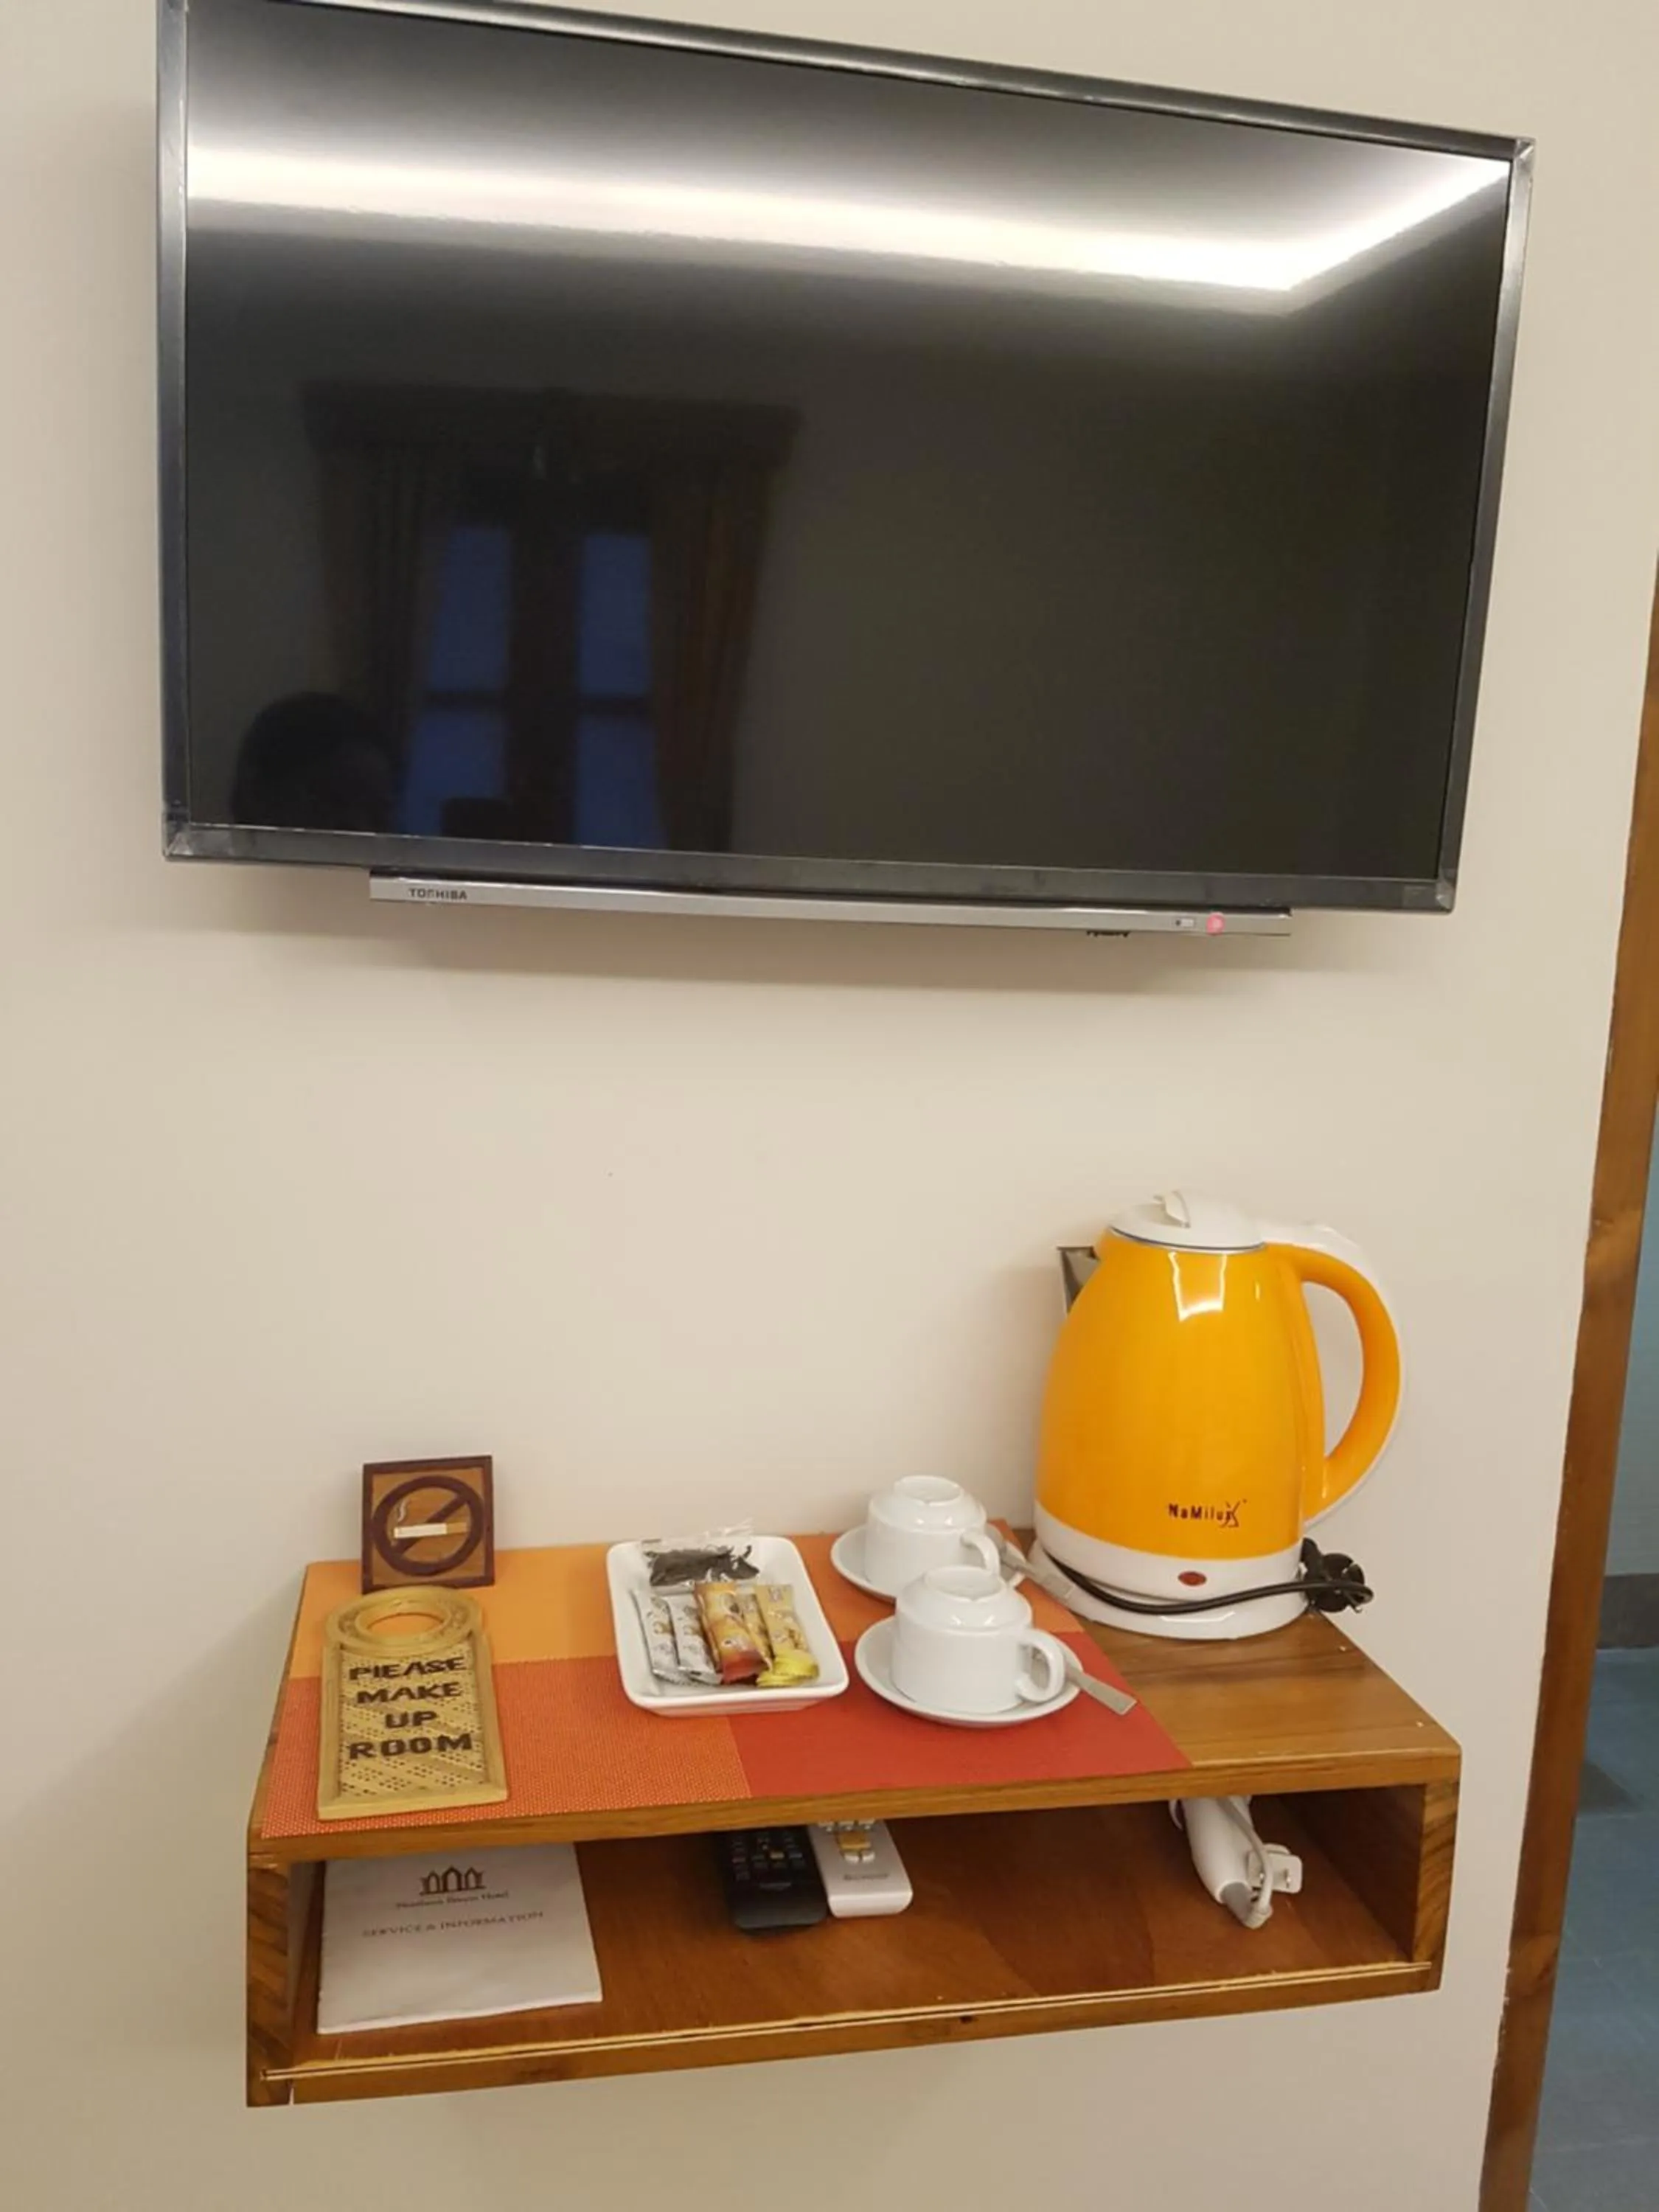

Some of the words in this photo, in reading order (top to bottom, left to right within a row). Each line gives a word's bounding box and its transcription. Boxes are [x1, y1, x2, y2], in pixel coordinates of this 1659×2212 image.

[409, 888, 467, 900] TOSHIBA
[357, 1682, 462, 1703] MAKE
[385, 1711, 437, 1728] UP
[349, 1733, 472, 1759] ROOM
[441, 1911, 543, 1930] INFORMATION
